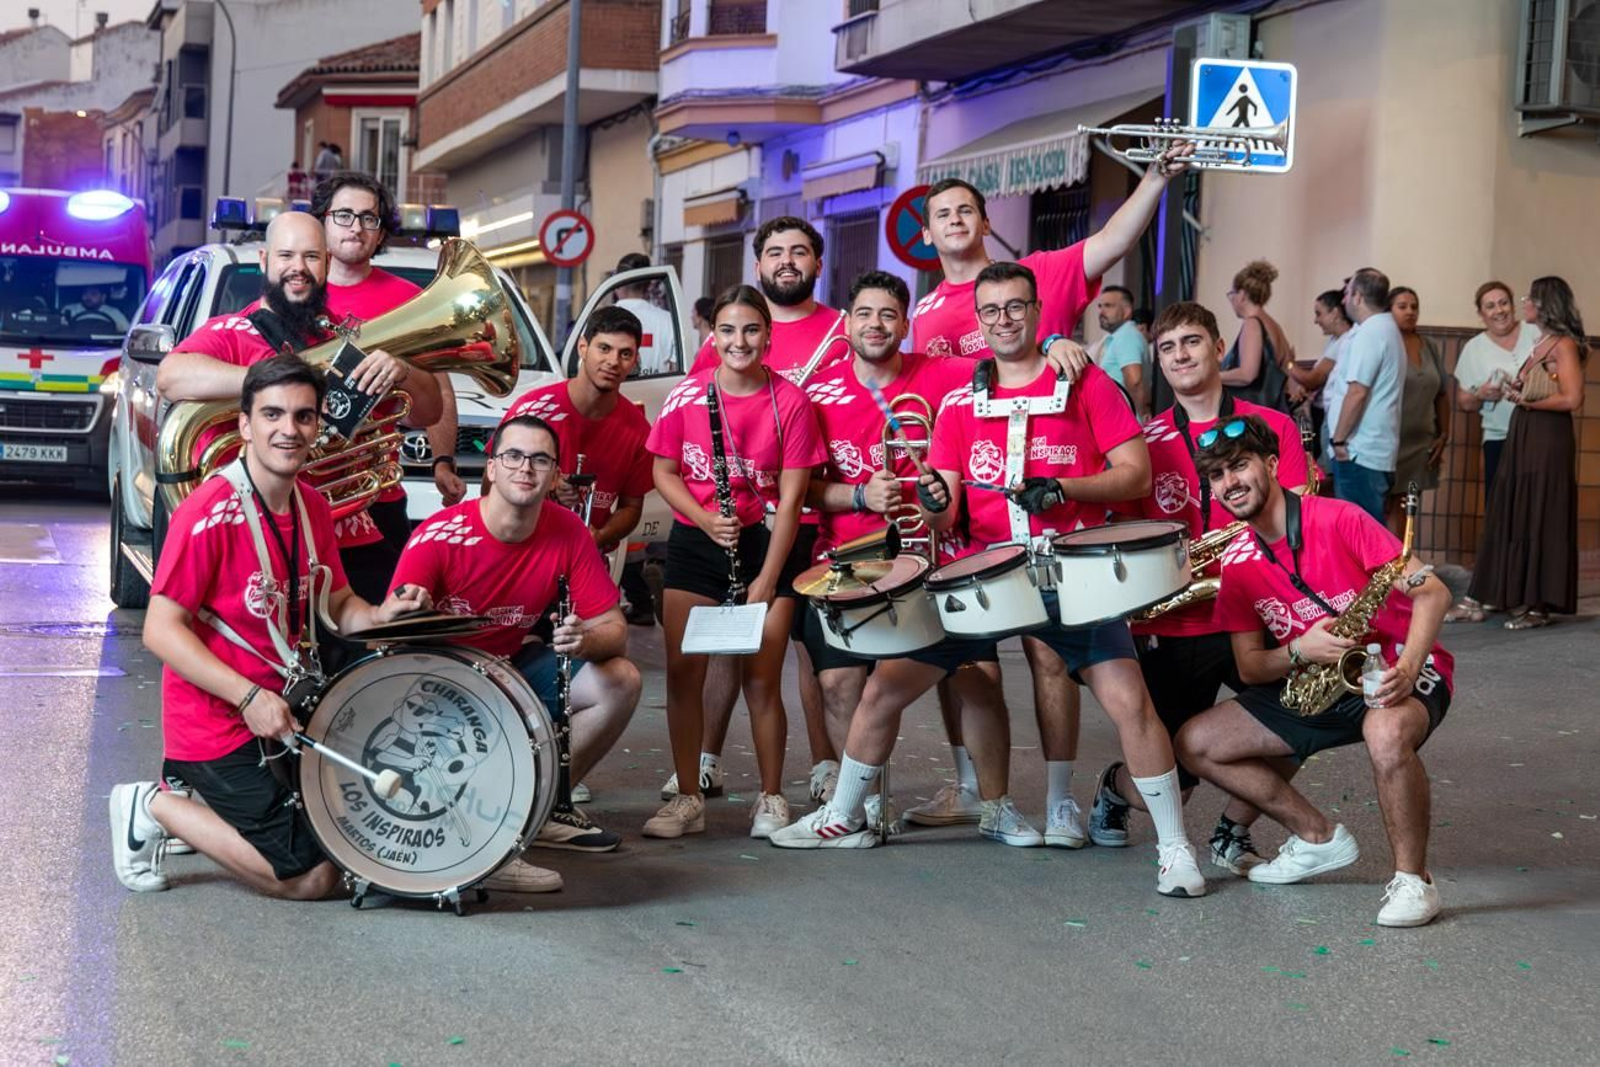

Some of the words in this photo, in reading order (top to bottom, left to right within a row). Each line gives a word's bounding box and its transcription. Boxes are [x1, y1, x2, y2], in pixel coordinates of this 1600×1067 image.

[6, 447, 38, 459] 2479
[420, 679, 488, 754] CHARANGA
[336, 816, 377, 851] MARTOS
[340, 782, 369, 812] LOS
[361, 811, 446, 848] INSPIRAOS
